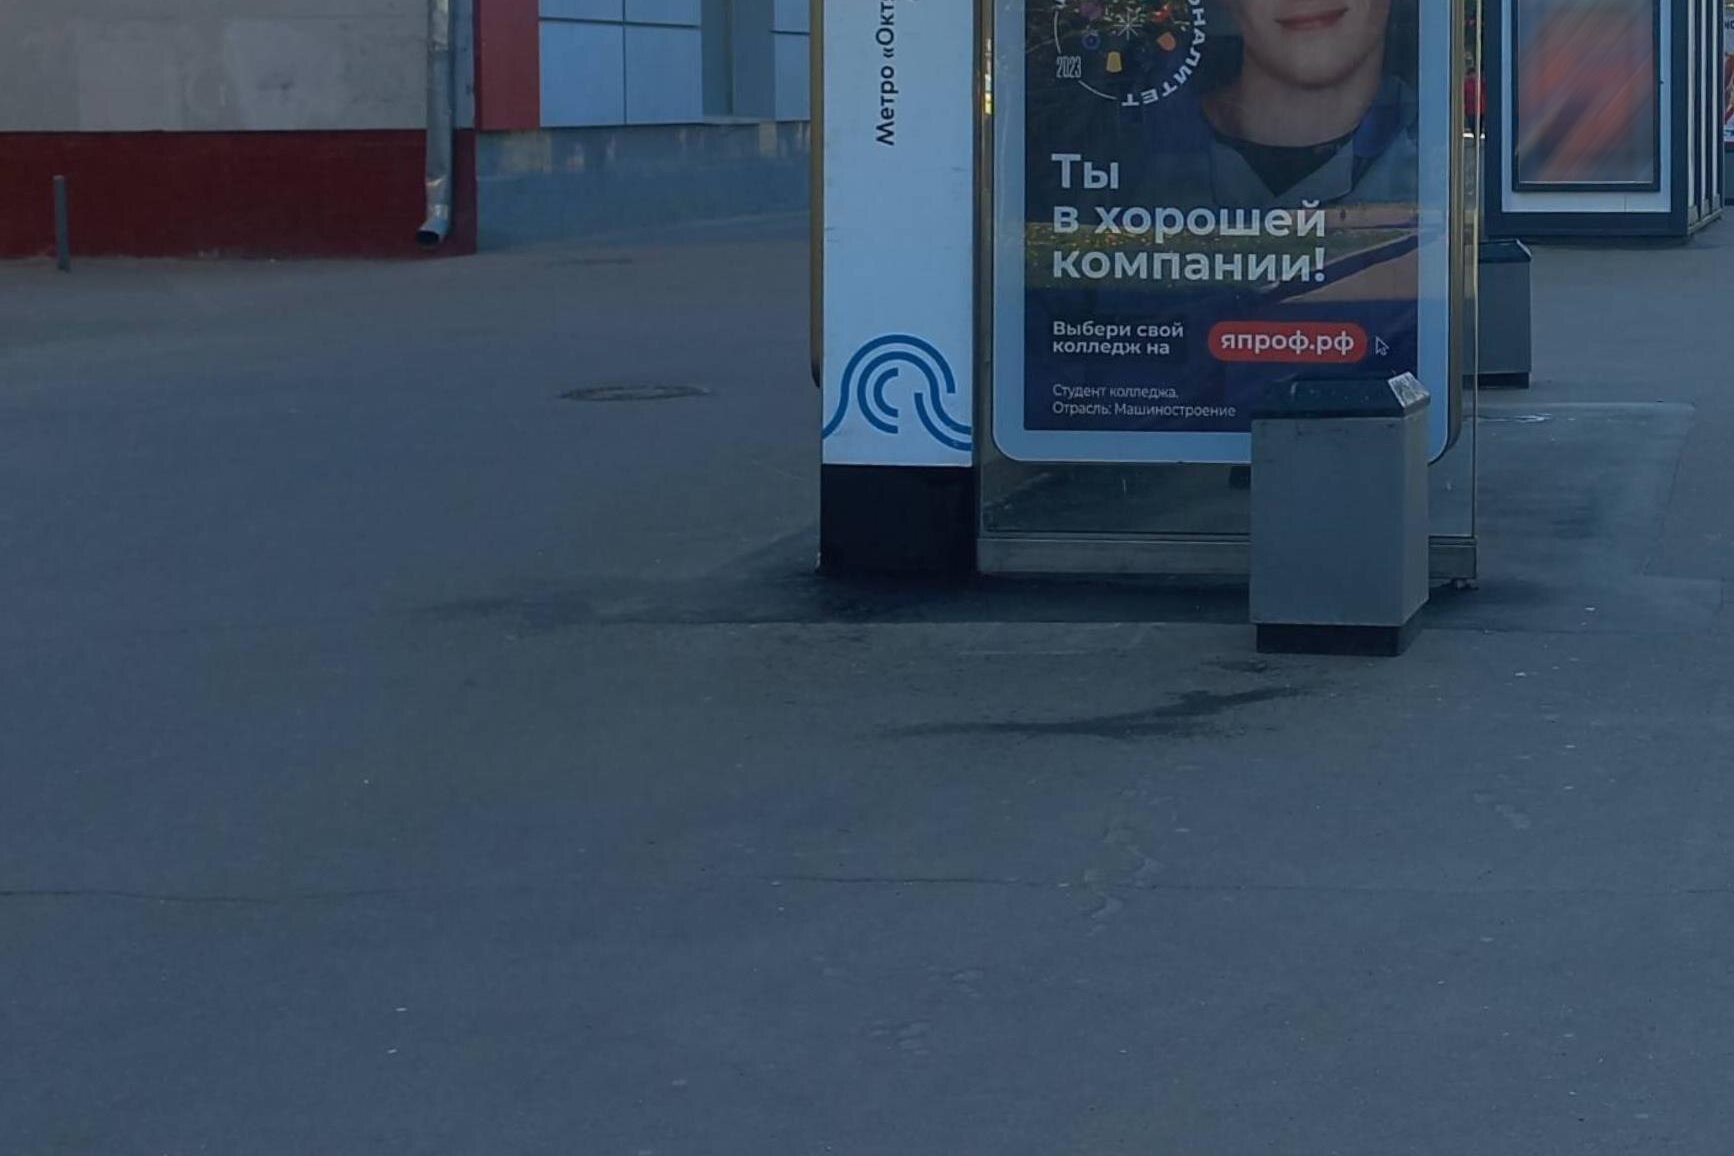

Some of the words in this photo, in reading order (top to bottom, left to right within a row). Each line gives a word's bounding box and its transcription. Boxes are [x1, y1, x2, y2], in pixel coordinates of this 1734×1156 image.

[1056, 55, 1082, 79] 2023
[875, 65, 899, 146] Метро
[1051, 152, 1120, 190] Ты
[1054, 206, 1079, 233] в
[1094, 200, 1326, 244] хорошей
[1053, 247, 1326, 283] компании!
[1053, 320, 1132, 340] Выбери
[1136, 321, 1184, 338] свой
[1053, 341, 1141, 356] колледж
[1146, 342, 1170, 355] на
[1221, 330, 1354, 356] япроф.рф
[1052, 384, 1106, 399] Студент
[1052, 401, 1112, 417] Отрасль:
[1114, 402, 1237, 418] Машиностроение
